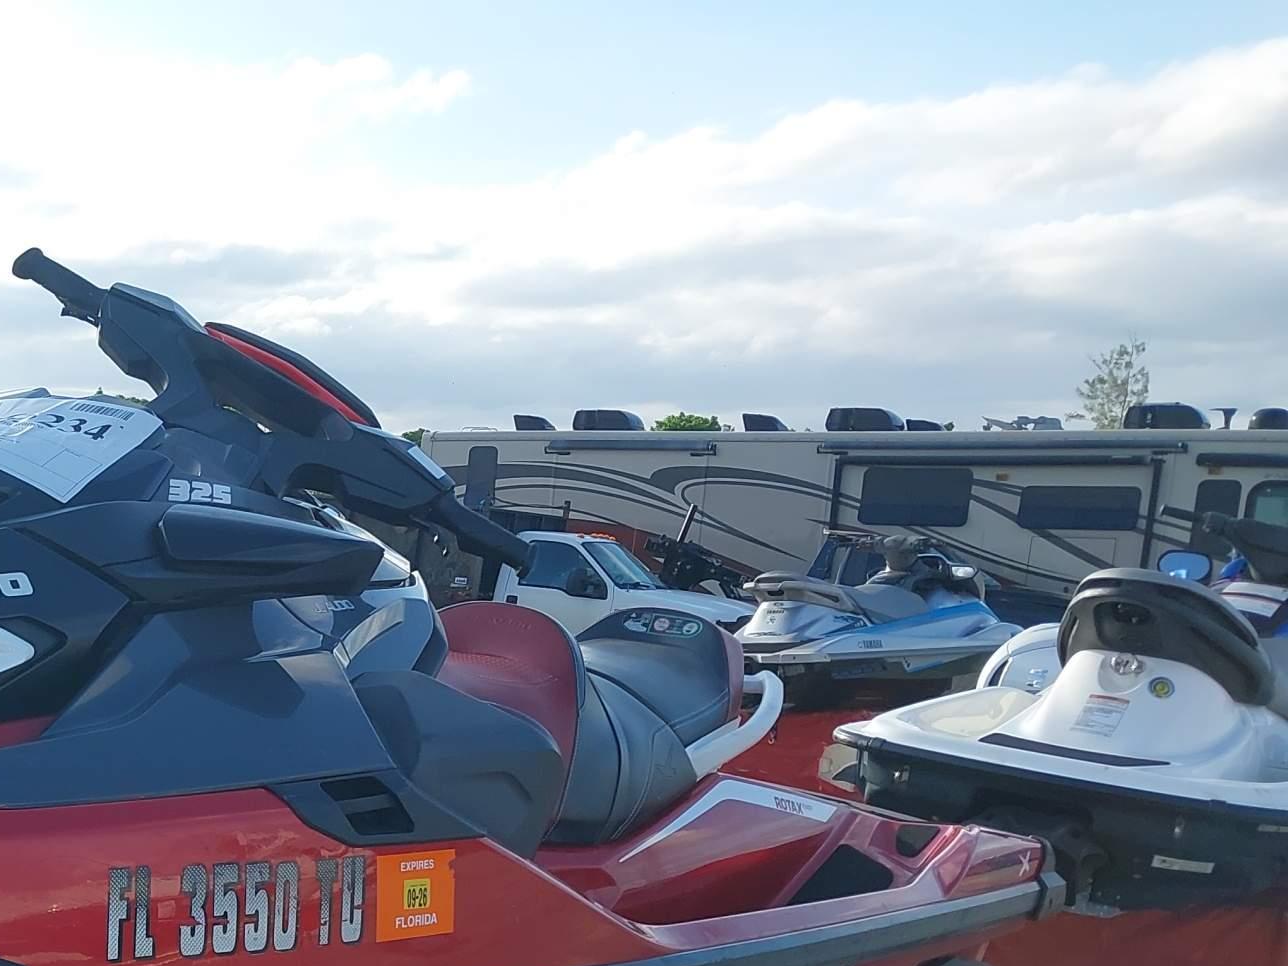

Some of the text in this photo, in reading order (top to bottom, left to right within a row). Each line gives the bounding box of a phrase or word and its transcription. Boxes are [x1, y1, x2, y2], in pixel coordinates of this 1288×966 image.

[168, 478, 231, 505] 325
[774, 796, 804, 815] ROTAX
[400, 859, 435, 872] EXPIRES
[107, 854, 367, 962] FL 3550 TU
[407, 888, 428, 909] 09-26
[395, 912, 438, 929] FLORIDA
